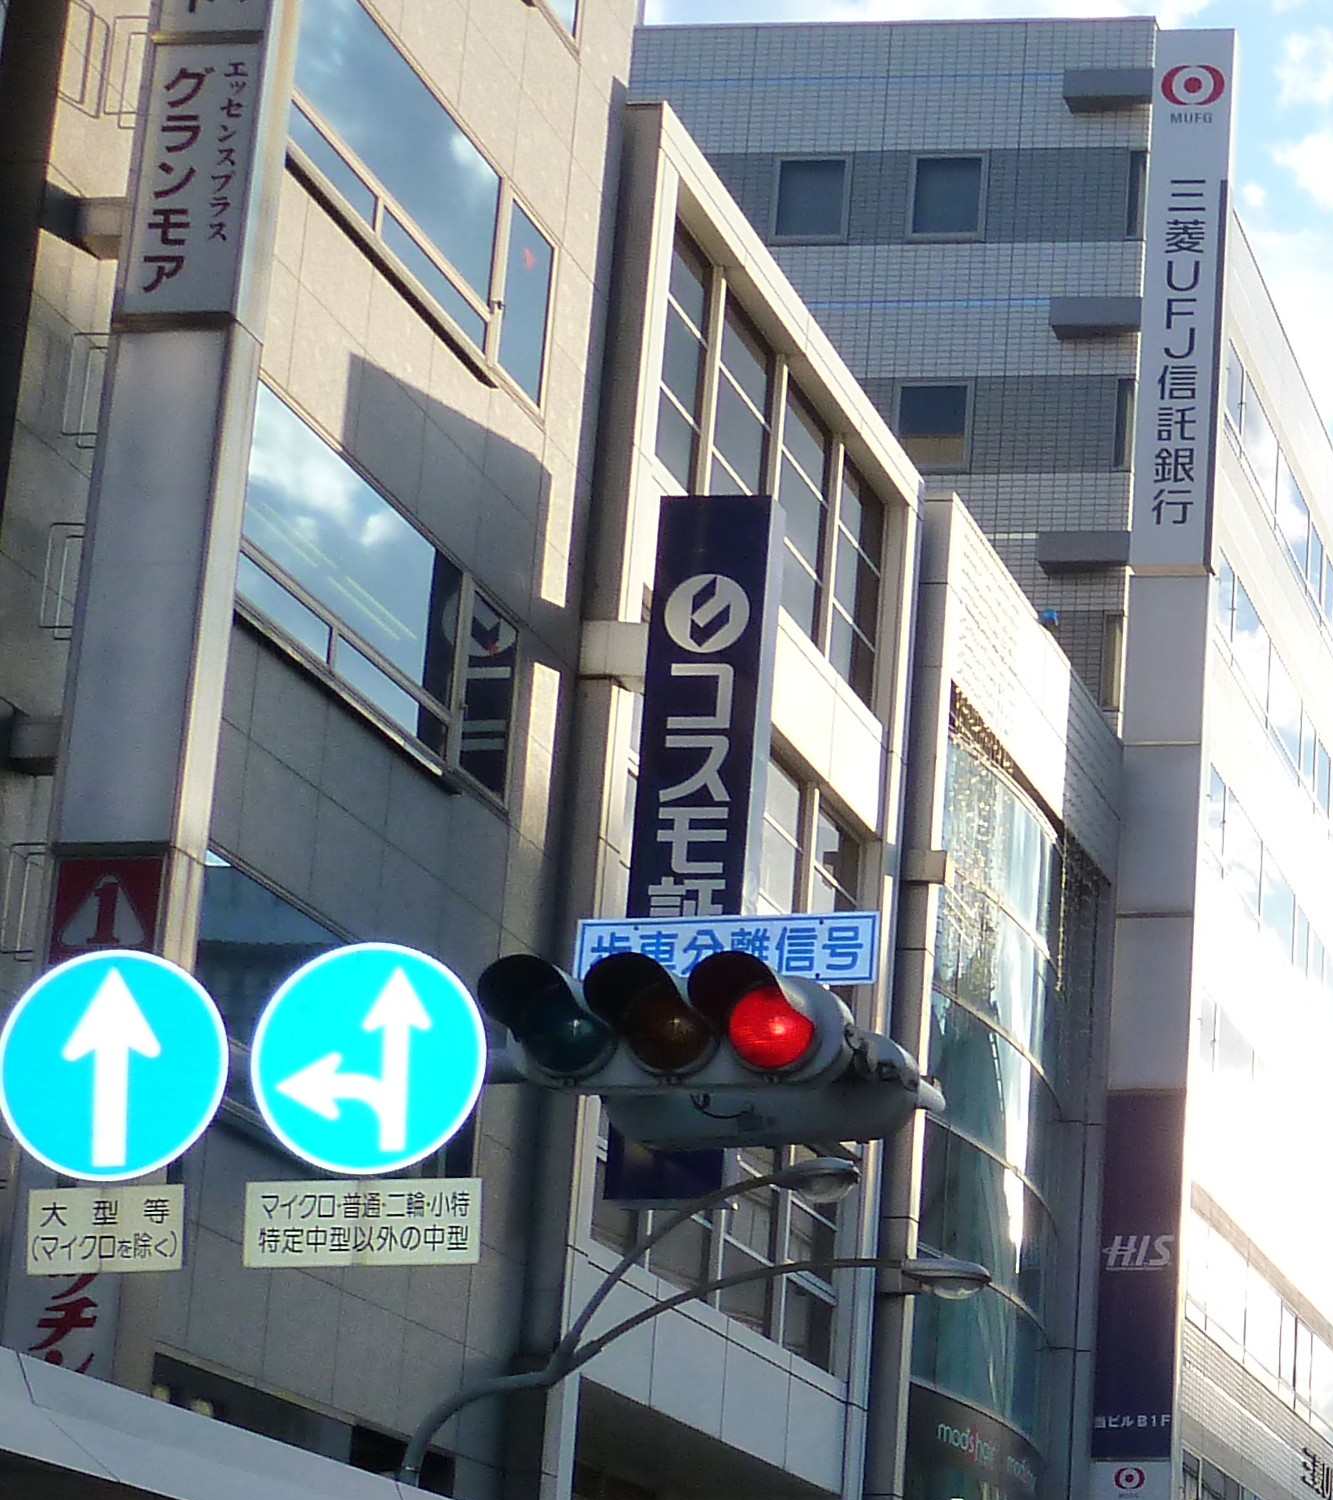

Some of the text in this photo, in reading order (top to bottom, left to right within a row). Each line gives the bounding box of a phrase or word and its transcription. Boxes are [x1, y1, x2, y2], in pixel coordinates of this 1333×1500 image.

[143, 67, 215, 293] グランモア
[208, 62, 248, 241] エッセンスプラス
[1170, 113, 1213, 124] MUFG
[1151, 179, 1206, 525] 三菱UFJ信託銀行
[259, 1225, 469, 1254] 特定中型以外の中型
